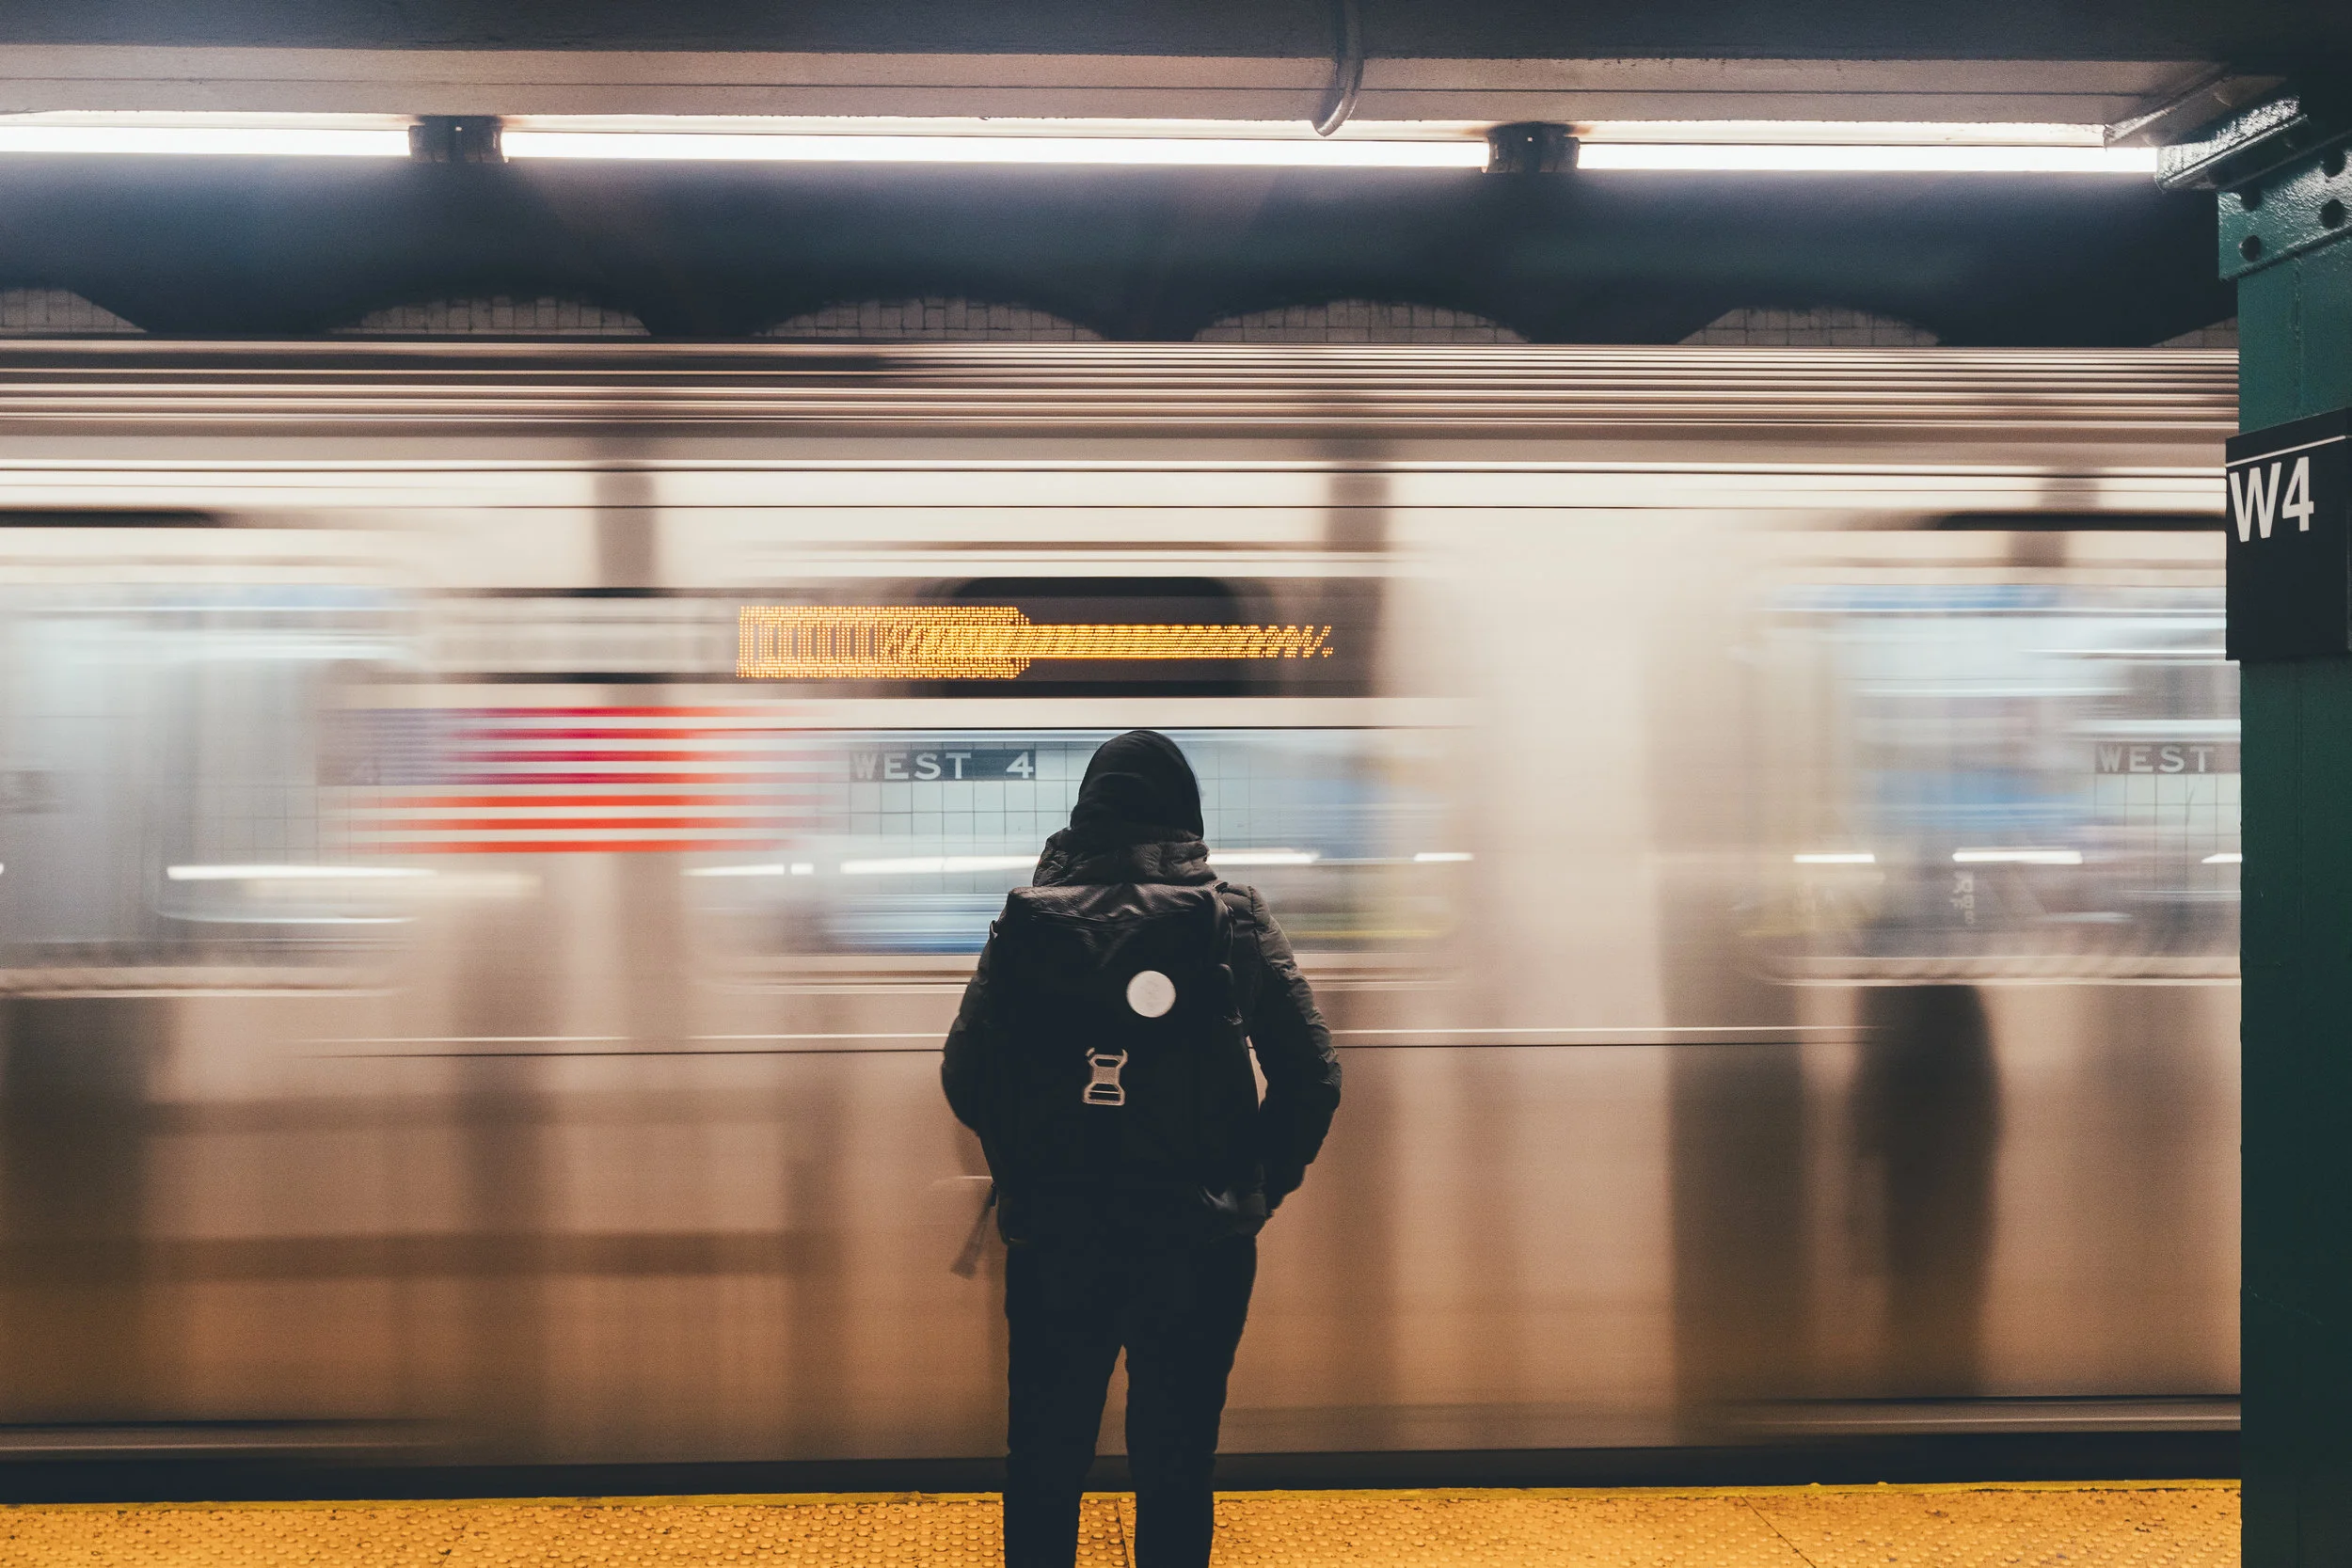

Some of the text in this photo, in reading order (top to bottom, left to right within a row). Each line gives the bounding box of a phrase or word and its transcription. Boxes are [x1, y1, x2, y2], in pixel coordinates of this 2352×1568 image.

[2229, 456, 2314, 543] W4
[853, 752, 1034, 780] WEST 4
[2097, 745, 2214, 772] WEST
